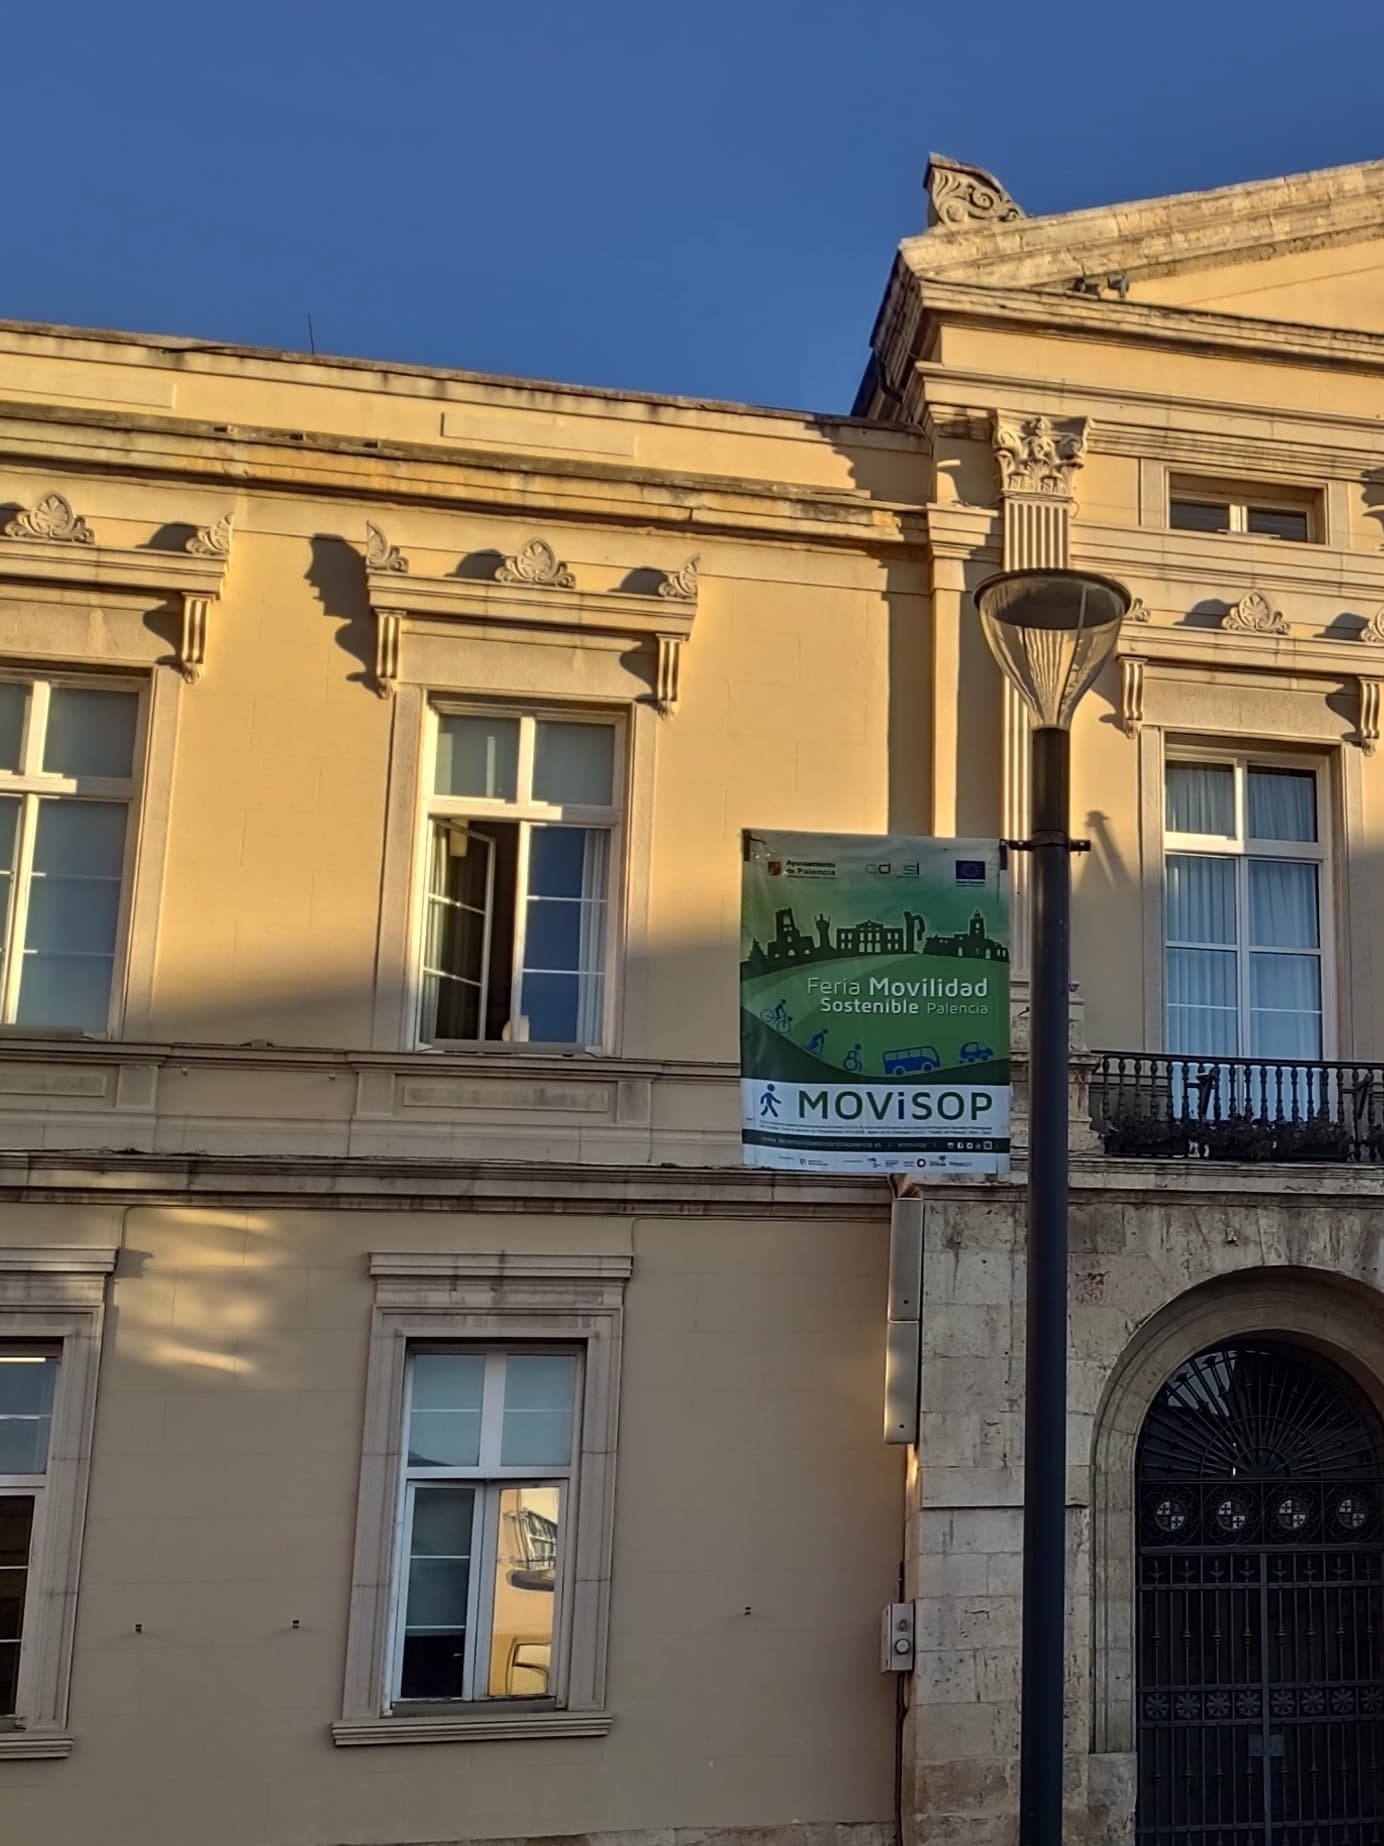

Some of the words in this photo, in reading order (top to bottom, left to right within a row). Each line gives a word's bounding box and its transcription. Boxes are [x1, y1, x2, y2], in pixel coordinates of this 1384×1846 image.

[797, 868, 836, 876] Palencia
[807, 977, 861, 995] Feria
[869, 977, 988, 998] Movilidad
[820, 998, 919, 1014] Sostenible
[927, 1002, 989, 1015] Palencia
